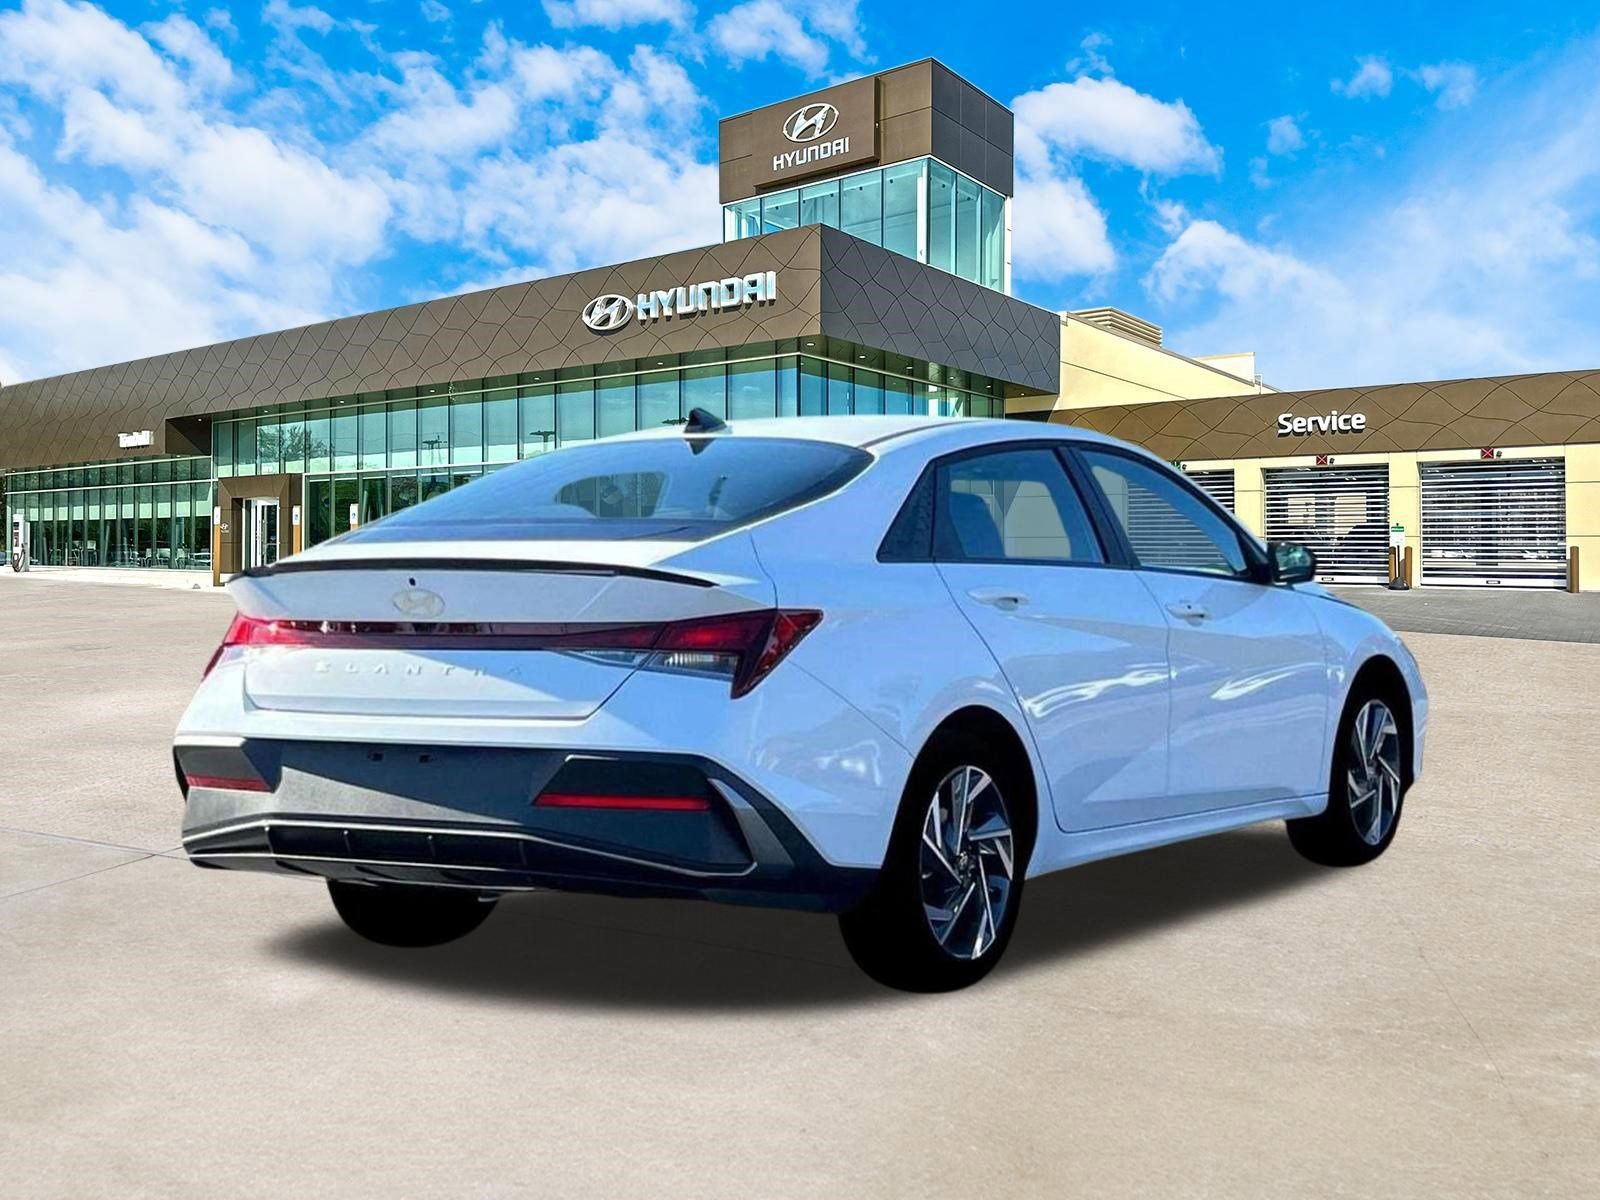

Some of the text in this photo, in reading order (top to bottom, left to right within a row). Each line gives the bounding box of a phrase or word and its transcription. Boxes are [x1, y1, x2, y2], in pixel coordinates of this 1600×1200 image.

[773, 137, 849, 171] HYUNDAI
[636, 271, 777, 320] HYUNDAI
[1277, 410, 1366, 434] Service
